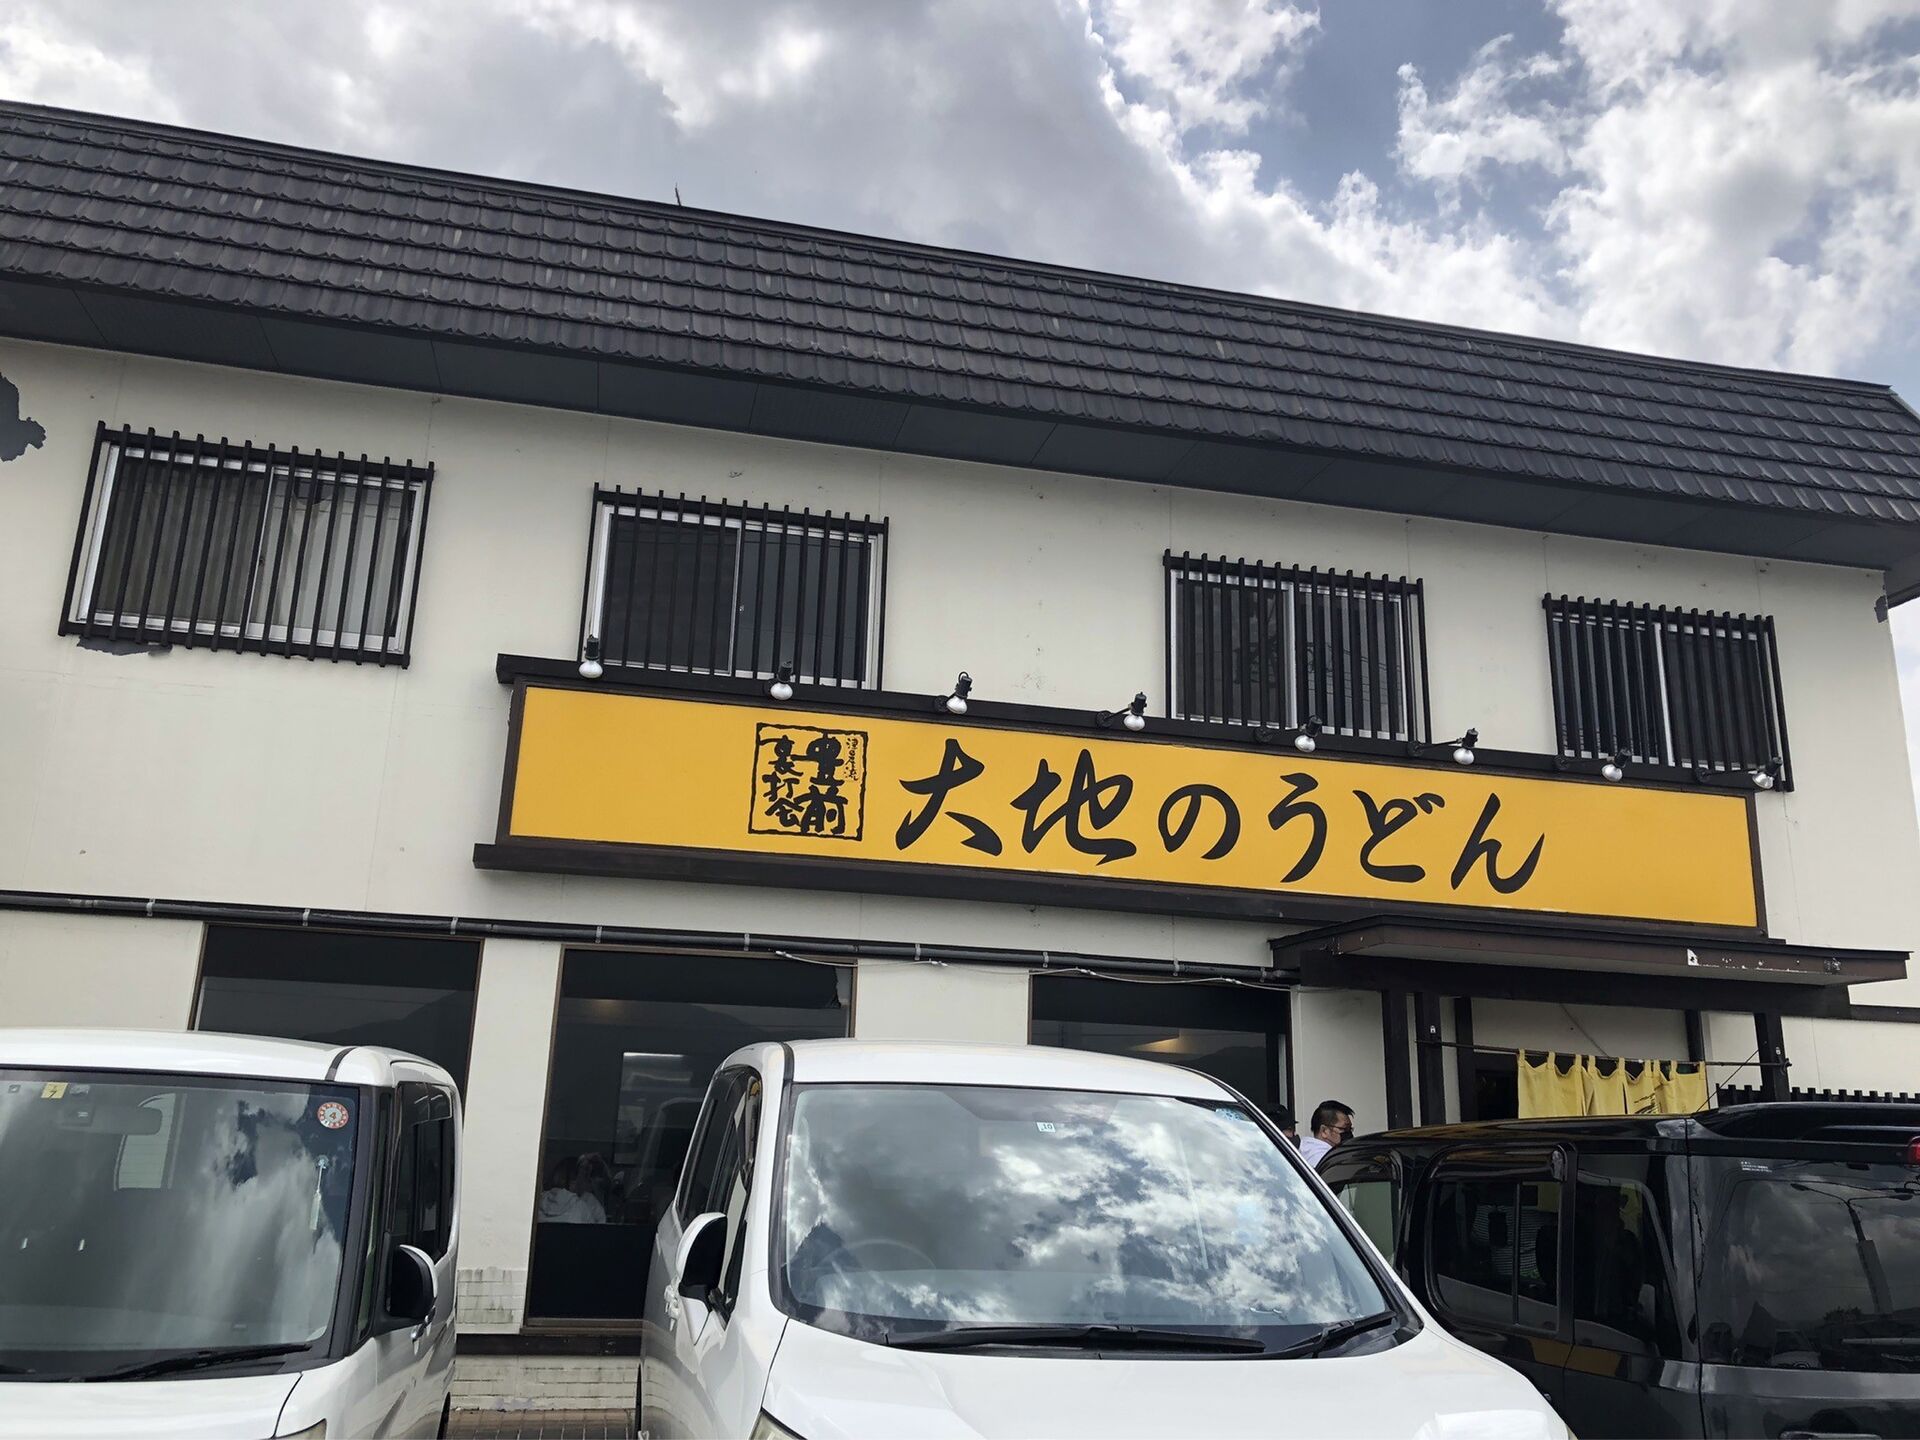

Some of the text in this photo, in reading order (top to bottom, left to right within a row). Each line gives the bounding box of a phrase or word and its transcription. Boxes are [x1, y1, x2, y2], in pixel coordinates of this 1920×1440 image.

[896, 739, 1544, 894] 大地のうどん
